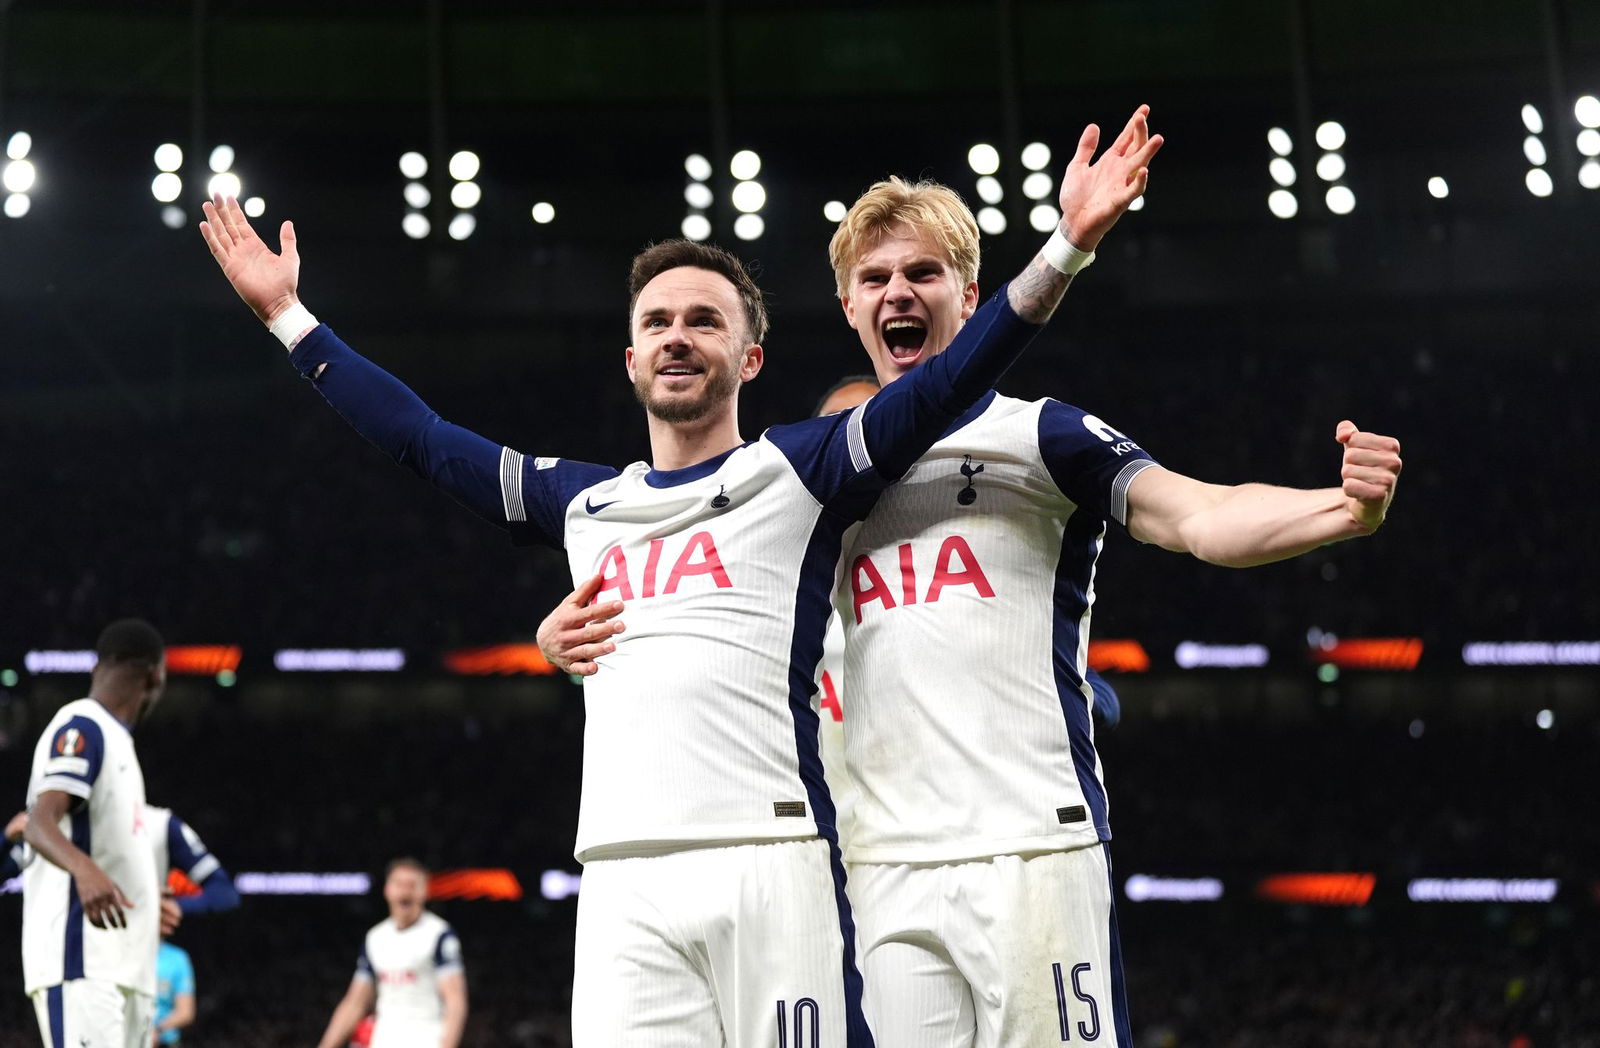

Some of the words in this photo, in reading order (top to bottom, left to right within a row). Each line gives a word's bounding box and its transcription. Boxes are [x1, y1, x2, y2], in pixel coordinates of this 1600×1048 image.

[590, 531, 733, 605] AIA
[851, 535, 996, 626] AIA
[1052, 962, 1101, 1042] 15
